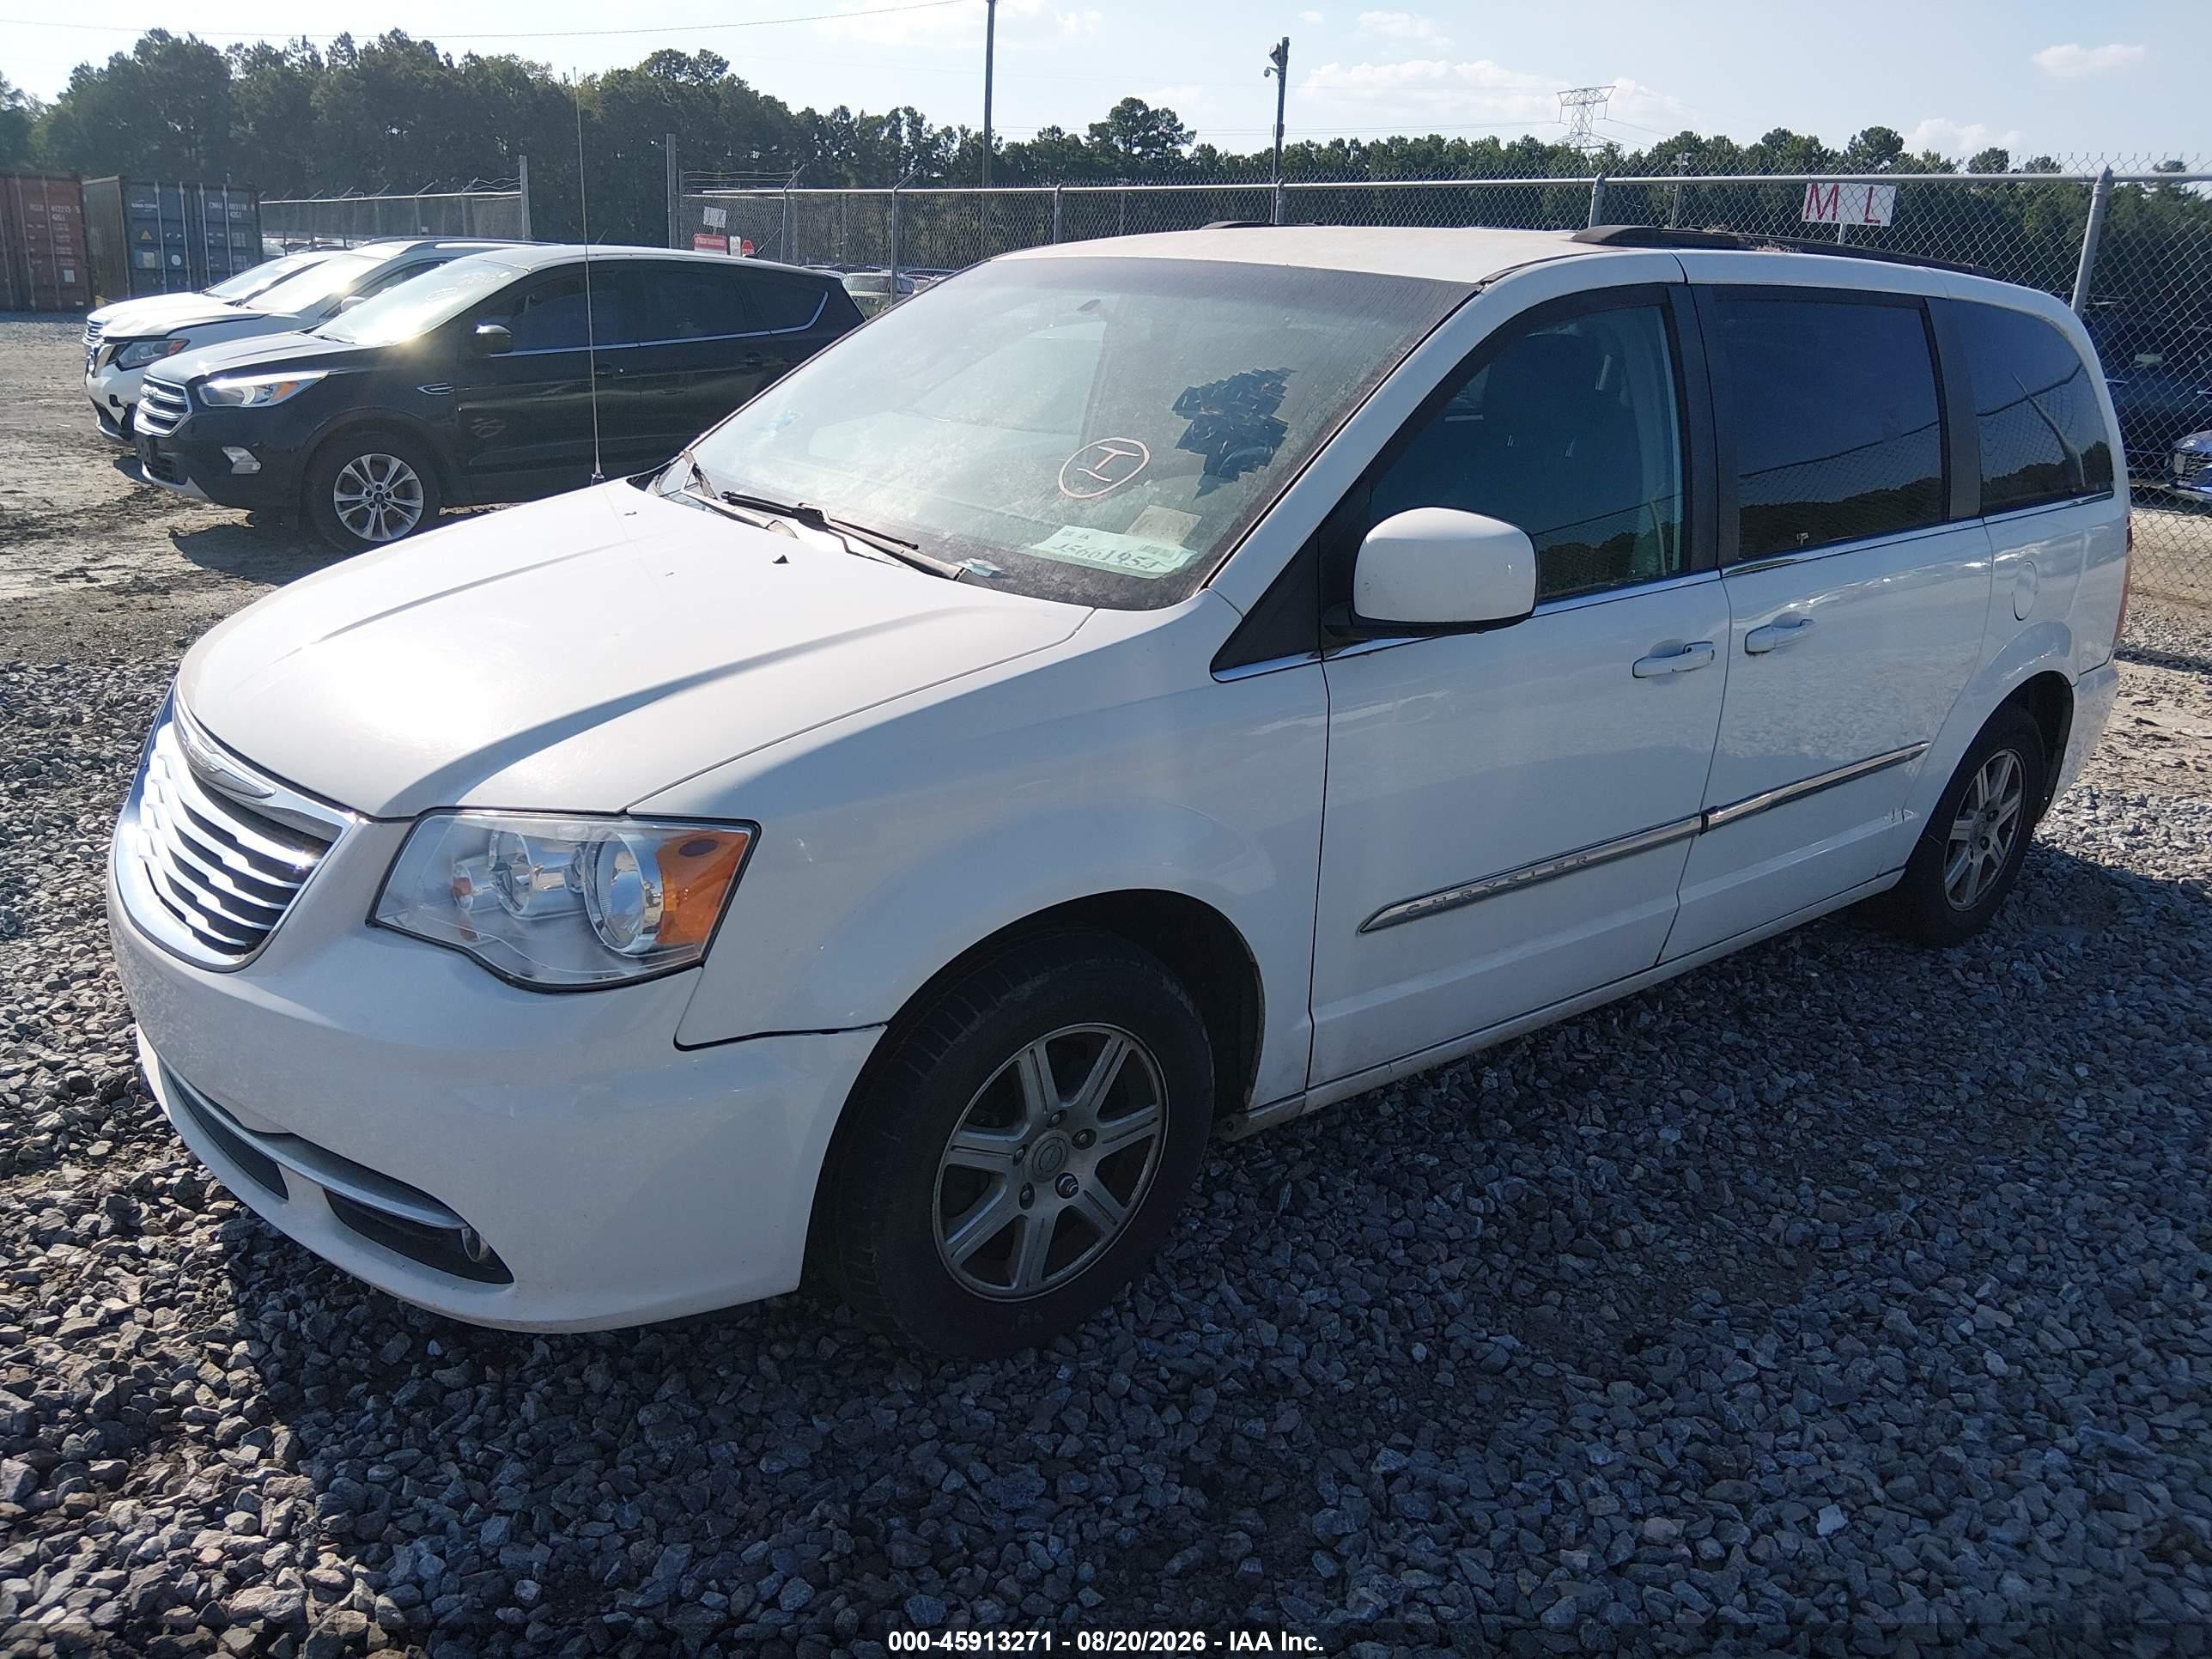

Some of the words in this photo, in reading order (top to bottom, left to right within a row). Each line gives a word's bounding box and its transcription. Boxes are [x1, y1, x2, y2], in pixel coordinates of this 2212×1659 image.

[1805, 182, 1839, 222] M
[1863, 185, 1881, 224] L
[1406, 855, 1588, 916] CHRYSLER
